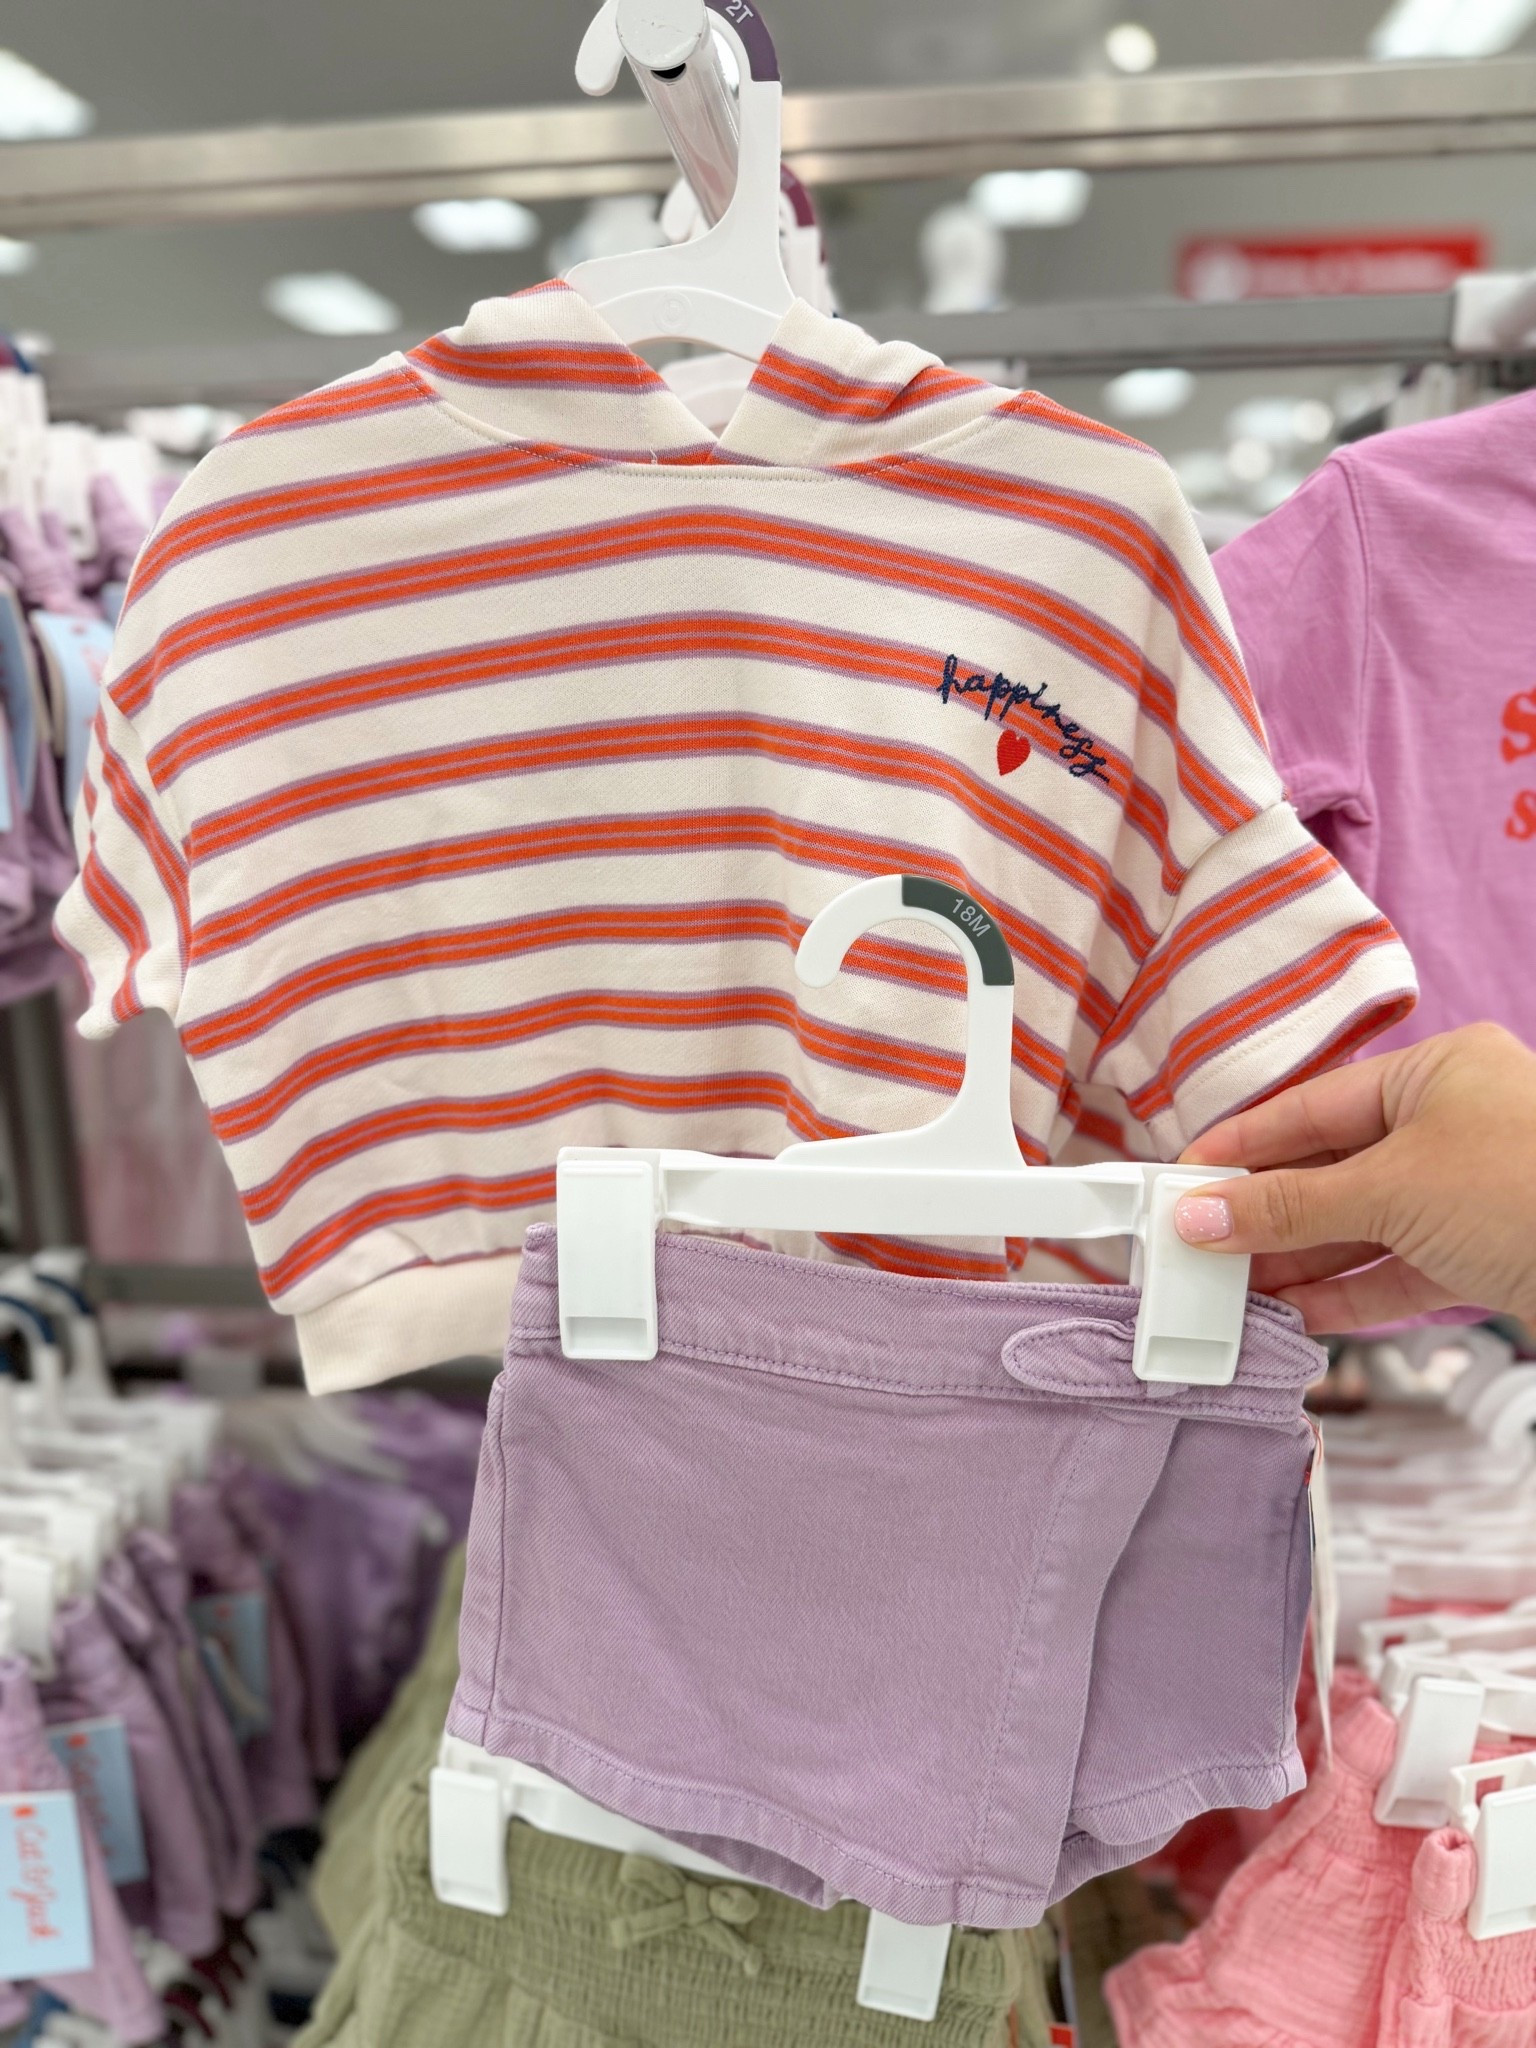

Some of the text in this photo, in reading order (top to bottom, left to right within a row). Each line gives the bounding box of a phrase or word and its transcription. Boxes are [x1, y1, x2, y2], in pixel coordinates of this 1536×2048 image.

[725, 0, 754, 24] 2T
[936, 654, 1110, 784] happiness
[952, 898, 991, 937] 18M
